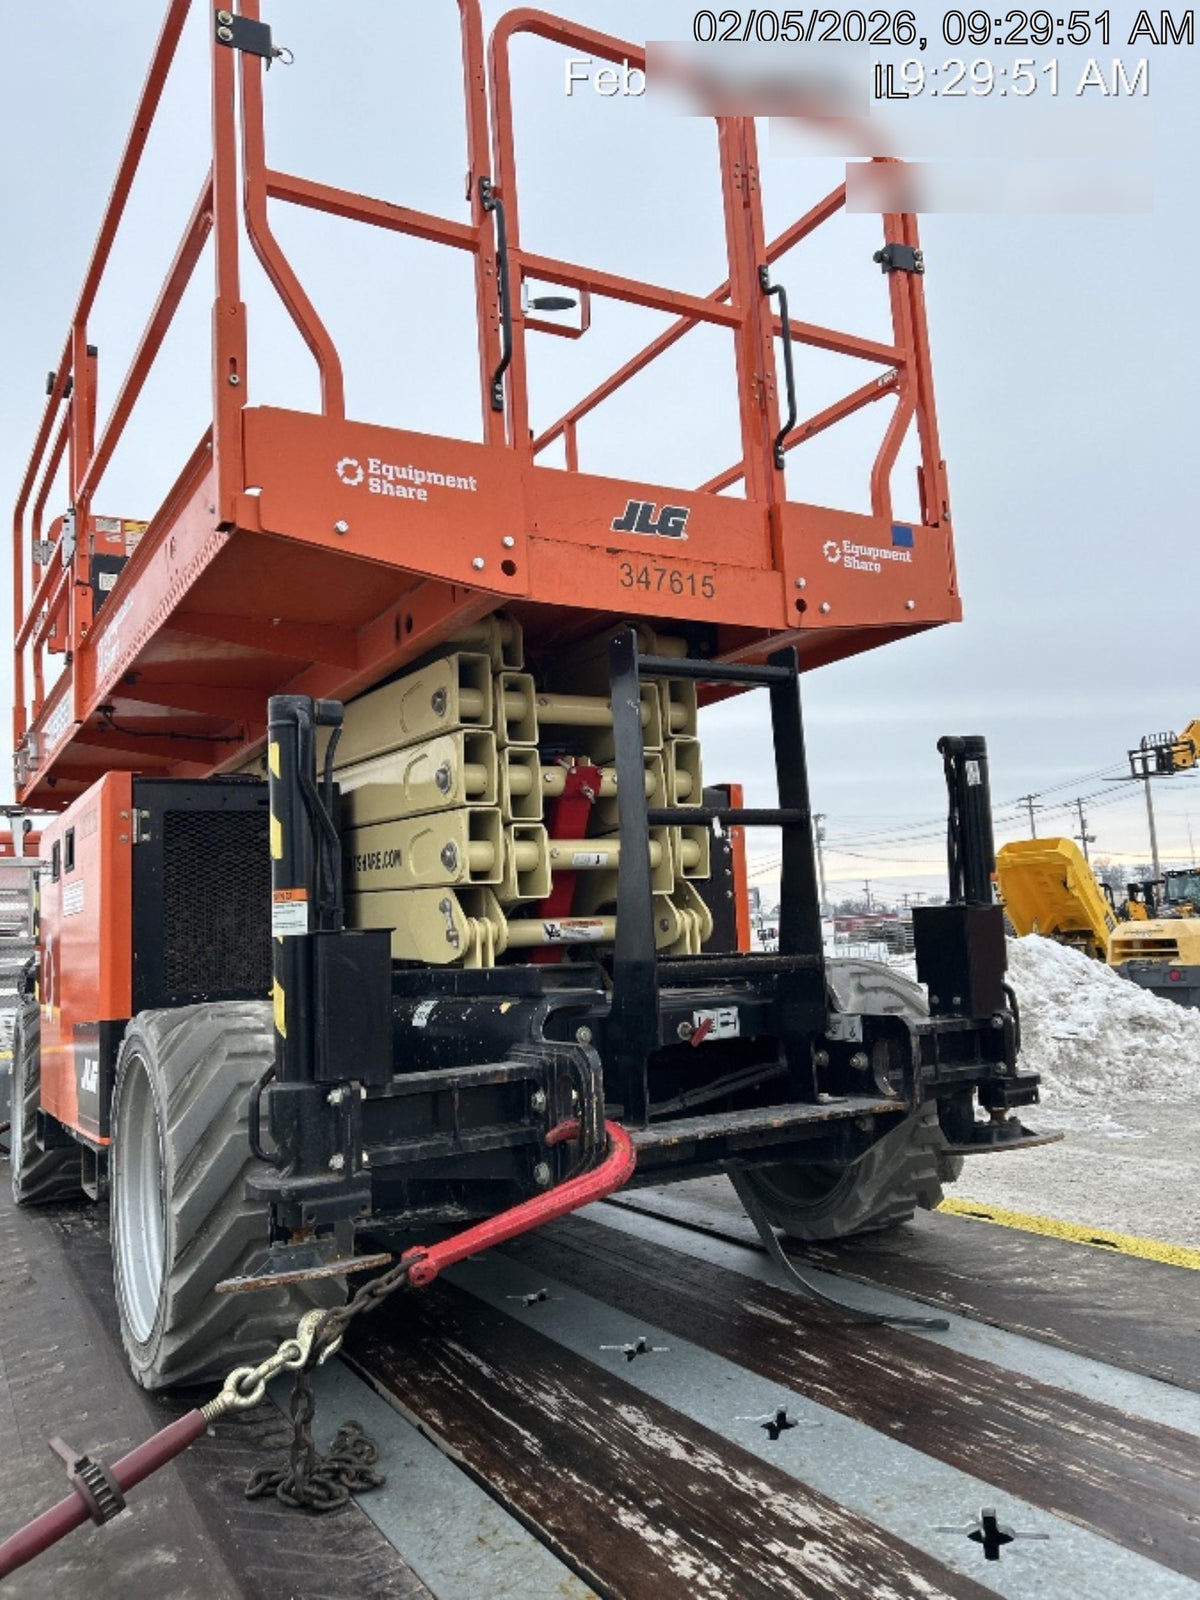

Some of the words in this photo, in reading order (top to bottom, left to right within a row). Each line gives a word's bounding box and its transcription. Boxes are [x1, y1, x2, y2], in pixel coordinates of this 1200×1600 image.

[367, 457, 478, 492] Equipment
[368, 477, 428, 502] Share
[609, 499, 691, 540] JLG
[842, 540, 913, 563] Equipment
[843, 556, 882, 574] Share
[619, 562, 716, 599] 347615
